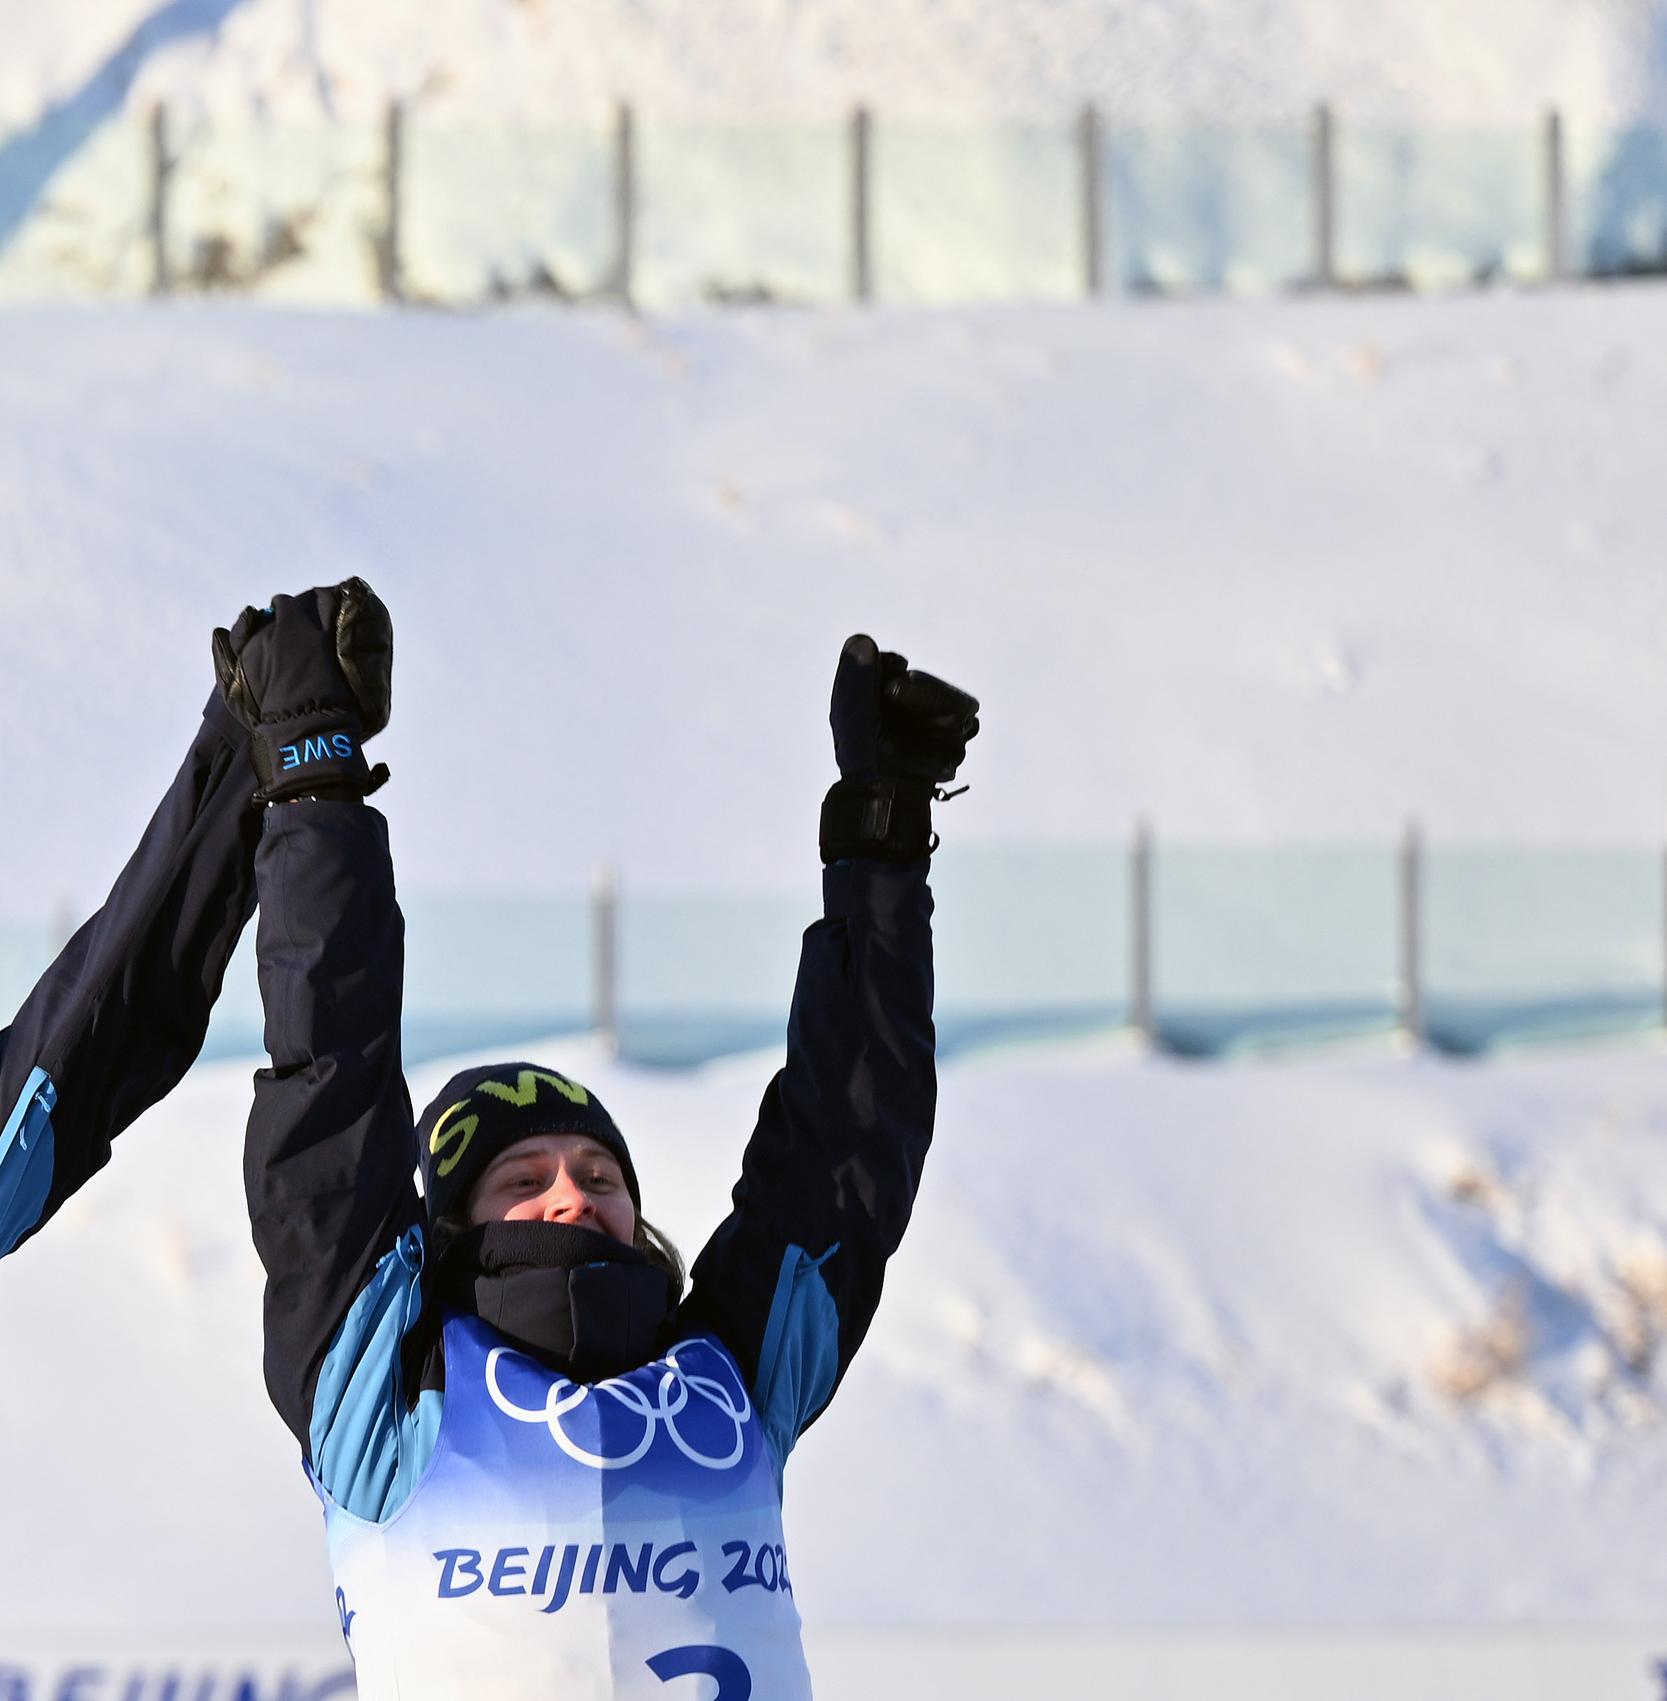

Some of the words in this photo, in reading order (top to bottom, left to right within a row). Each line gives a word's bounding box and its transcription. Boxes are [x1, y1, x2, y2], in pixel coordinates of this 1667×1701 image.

[279, 733, 353, 770] SWE
[432, 1541, 700, 1614] BEIJING
[721, 1541, 793, 1599] 202
